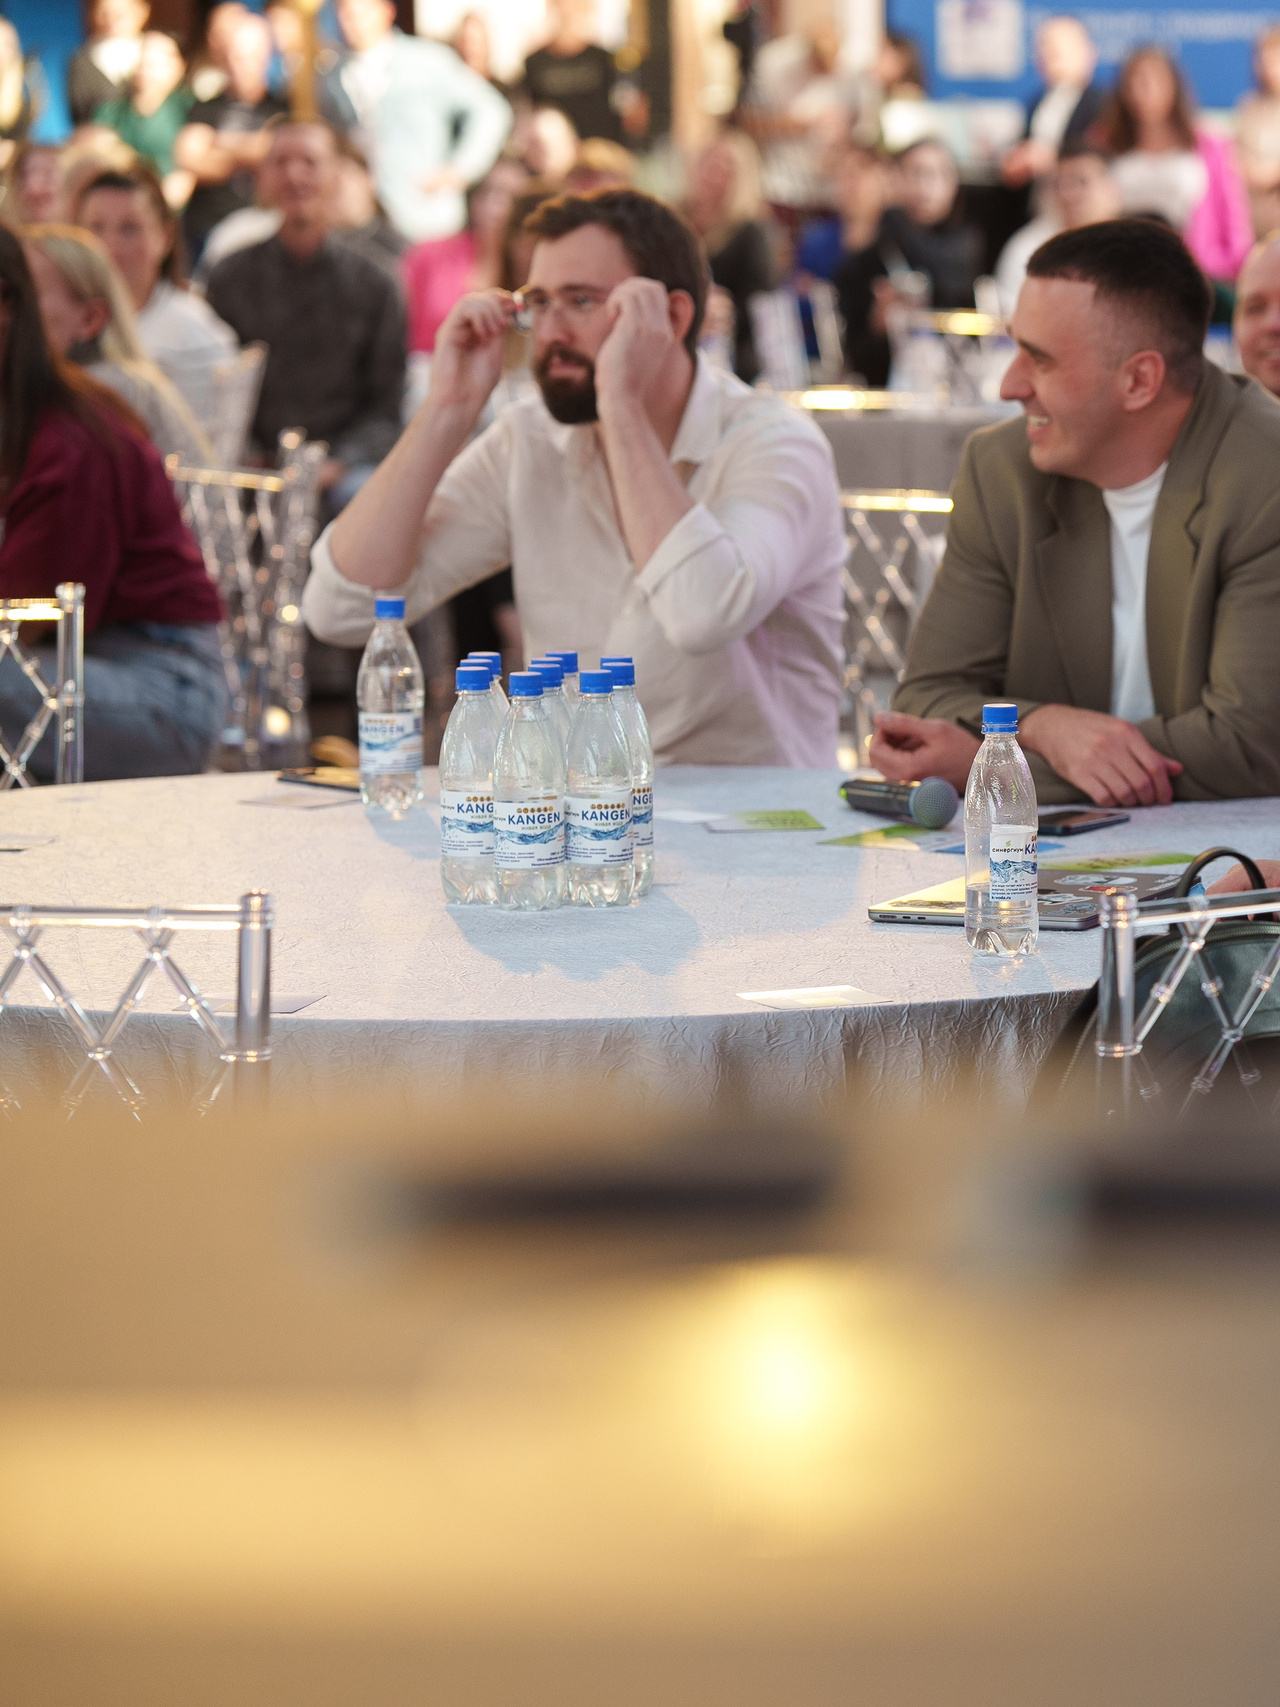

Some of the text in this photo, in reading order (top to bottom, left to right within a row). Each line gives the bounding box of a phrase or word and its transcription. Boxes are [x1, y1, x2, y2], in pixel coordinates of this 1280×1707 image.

[457, 803, 494, 814] KANG
[508, 812, 560, 825] KANGEN
[582, 810, 630, 820] KANGEN
